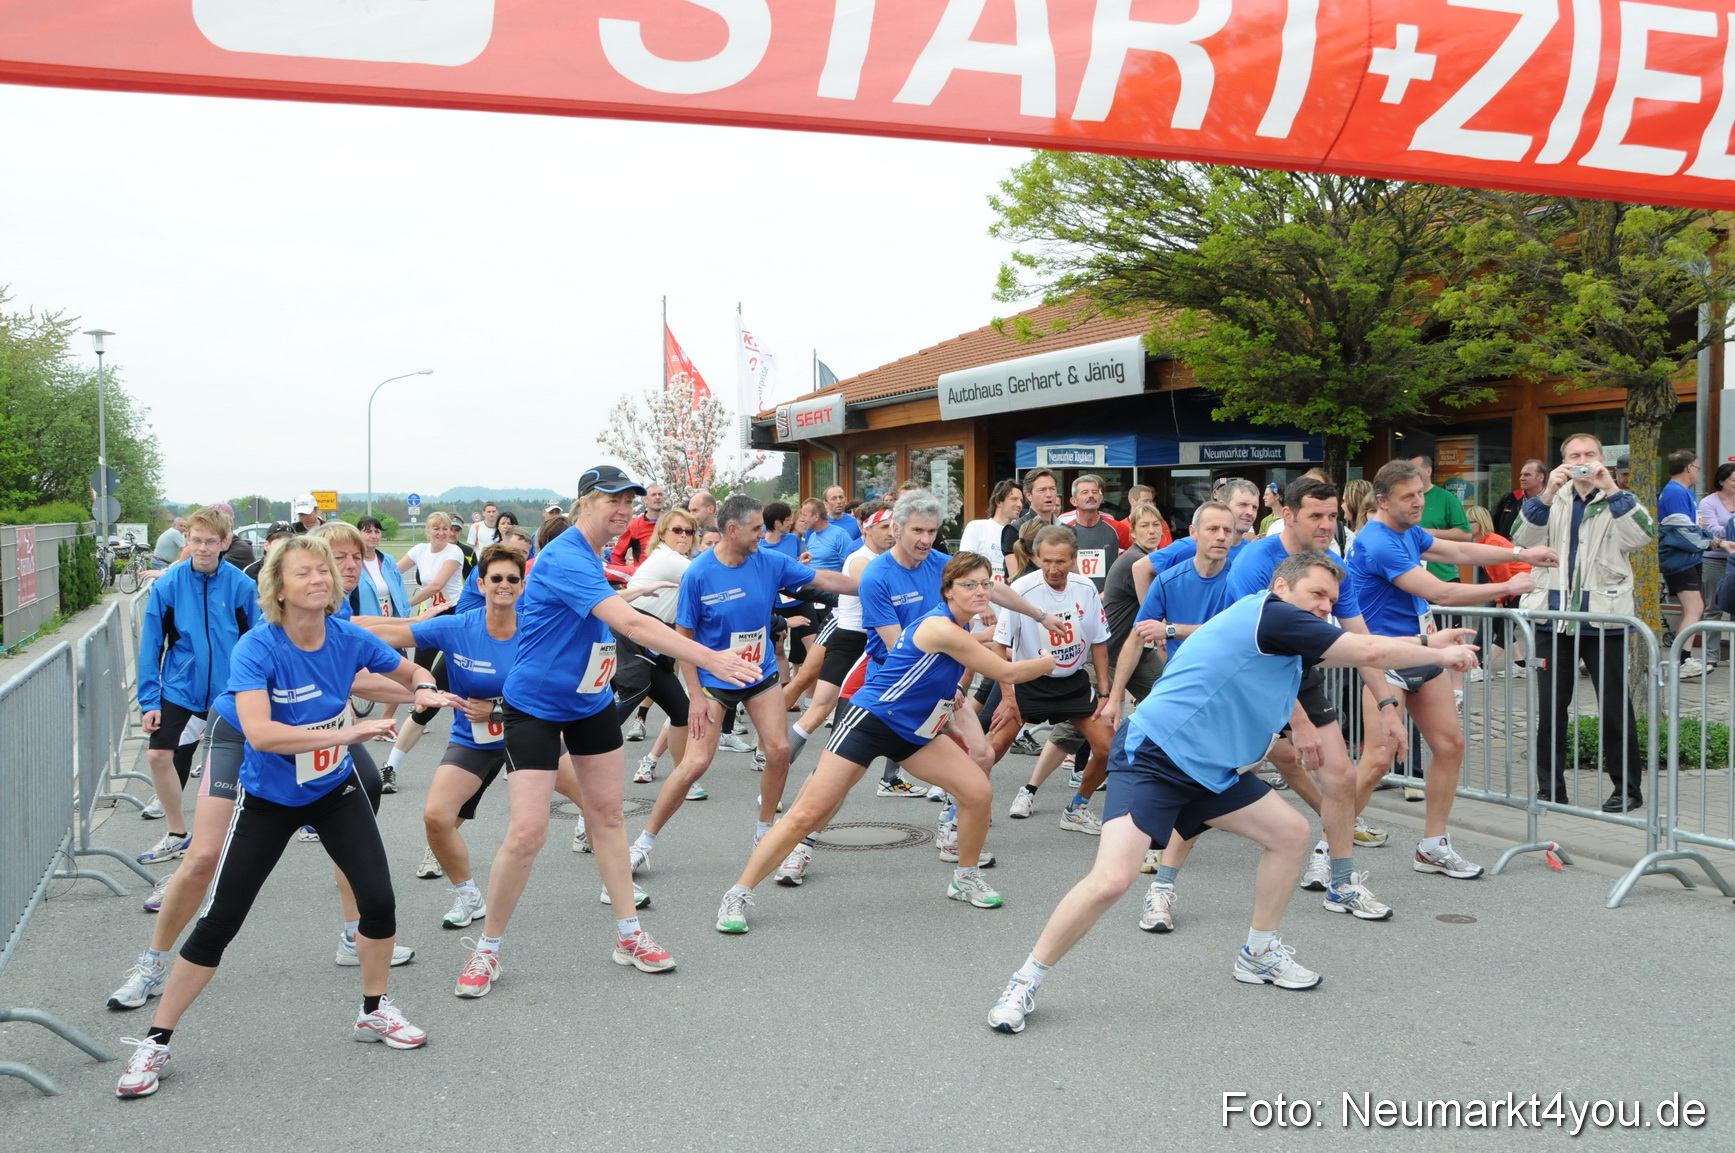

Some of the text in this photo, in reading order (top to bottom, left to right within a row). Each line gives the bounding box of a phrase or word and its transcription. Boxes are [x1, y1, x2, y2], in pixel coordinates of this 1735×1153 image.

[948, 357, 1125, 404] Autohaus Gerhart & Jänig
[795, 407, 833, 428] SEAT
[1204, 446, 1282, 459] Neumarkter Tagblatt
[1082, 558, 1099, 575] 87
[430, 591, 447, 607] 24
[593, 656, 616, 687] 21
